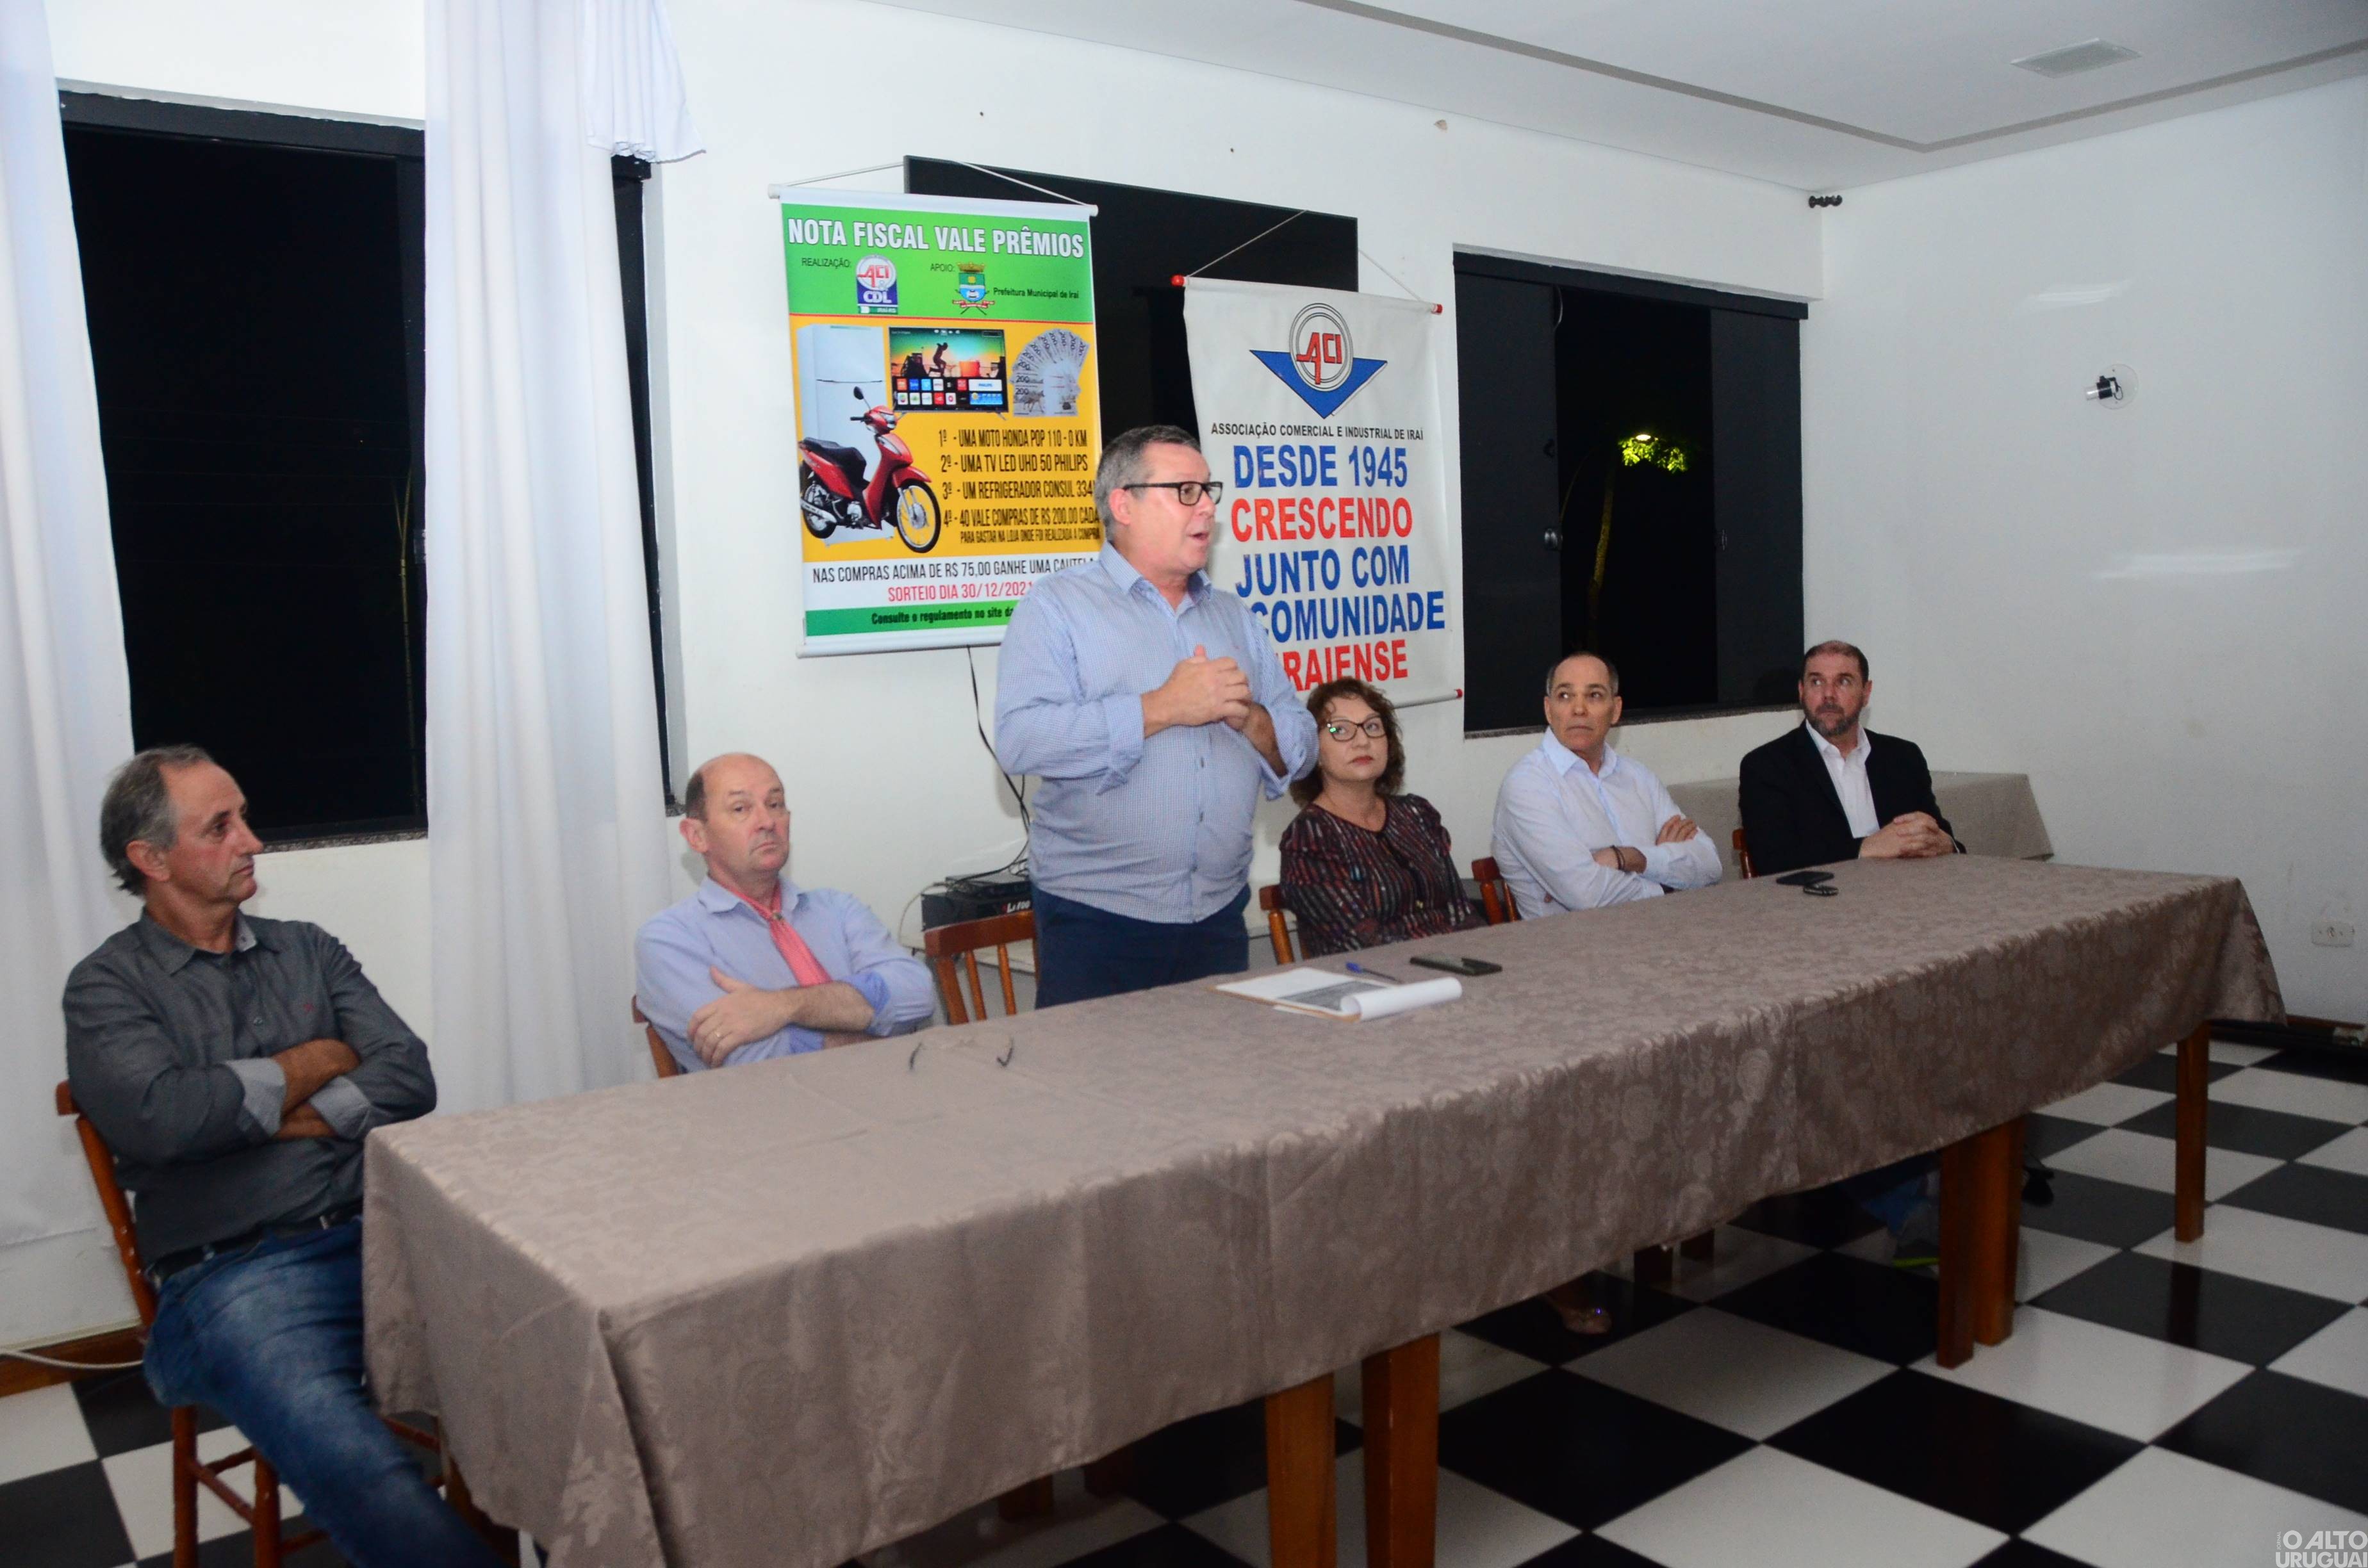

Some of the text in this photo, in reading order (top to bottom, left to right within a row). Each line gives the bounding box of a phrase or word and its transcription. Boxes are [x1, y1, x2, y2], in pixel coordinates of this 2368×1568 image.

[788, 218, 1084, 258] NOTA FISCAL VALE PRÊMIOS
[930, 263, 955, 272] APOIO:
[863, 290, 892, 304] CDL
[993, 287, 1025, 297] Prefeitura
[1026, 288, 1058, 299] Municipal
[1059, 290, 1068, 298] de
[1296, 332, 1343, 384] ACI
[1015, 375, 1030, 384] 200
[958, 429, 977, 447] UMA
[978, 429, 1000, 447] MOTO
[1002, 429, 1028, 447] HONDA
[1031, 429, 1046, 447] POP
[1048, 429, 1062, 447] 110
[1069, 429, 1073, 446] 0
[1075, 429, 1088, 447] KM
[1211, 421, 1277, 439] ASSOCIAÇÃO
[1279, 425, 1335, 437] COMERCIAL
[1337, 426, 1344, 437] E
[1345, 426, 1393, 439] INDUSTRIAL
[1394, 429, 1405, 440] DE
[941, 455, 951, 473] 2º
[960, 454, 983, 473] UMA
[984, 454, 996, 473] TV
[999, 454, 1017, 472] LED
[1019, 454, 1038, 472] UHD
[1040, 454, 1052, 472] 50
[1055, 453, 1089, 471] PHILIPS
[1233, 445, 1408, 488] DESDE 1945
[942, 482, 952, 500] 3º
[962, 481, 977, 500] UM
[978, 480, 1042, 499] REFRIGERADOR
[1043, 480, 1075, 498] CONSUL
[960, 509, 970, 527] 40
[971, 508, 991, 527] VALE
[992, 507, 1028, 527] COMPRAS
[1030, 507, 1040, 525] DE
[1040, 507, 1051, 525] R$
[1053, 507, 1078, 526] 200,00
[1080, 506, 1100, 524] CADA
[1231, 497, 1413, 543] CRESCENDO
[960, 530, 974, 543] PARA
[976, 530, 996, 543] GASTAR
[998, 530, 1005, 543] NA
[1021, 529, 1035, 542] ONDE
[1035, 528, 1044, 541] FOI
[813, 558, 1094, 583] NAS COMPRAS ACIMA DE R$ 75,00 GANHE UMA CAUT
[1235, 544, 1410, 598] JUNTO COM
[888, 585, 937, 603] SORTEIO
[940, 584, 958, 600] DIA
[871, 611, 909, 625] Consulte
[912, 613, 917, 623] o
[919, 609, 973, 624] regulamento
[974, 610, 985, 619] no
[987, 606, 1002, 618] site
[1276, 639, 1408, 692] RAIENSE
